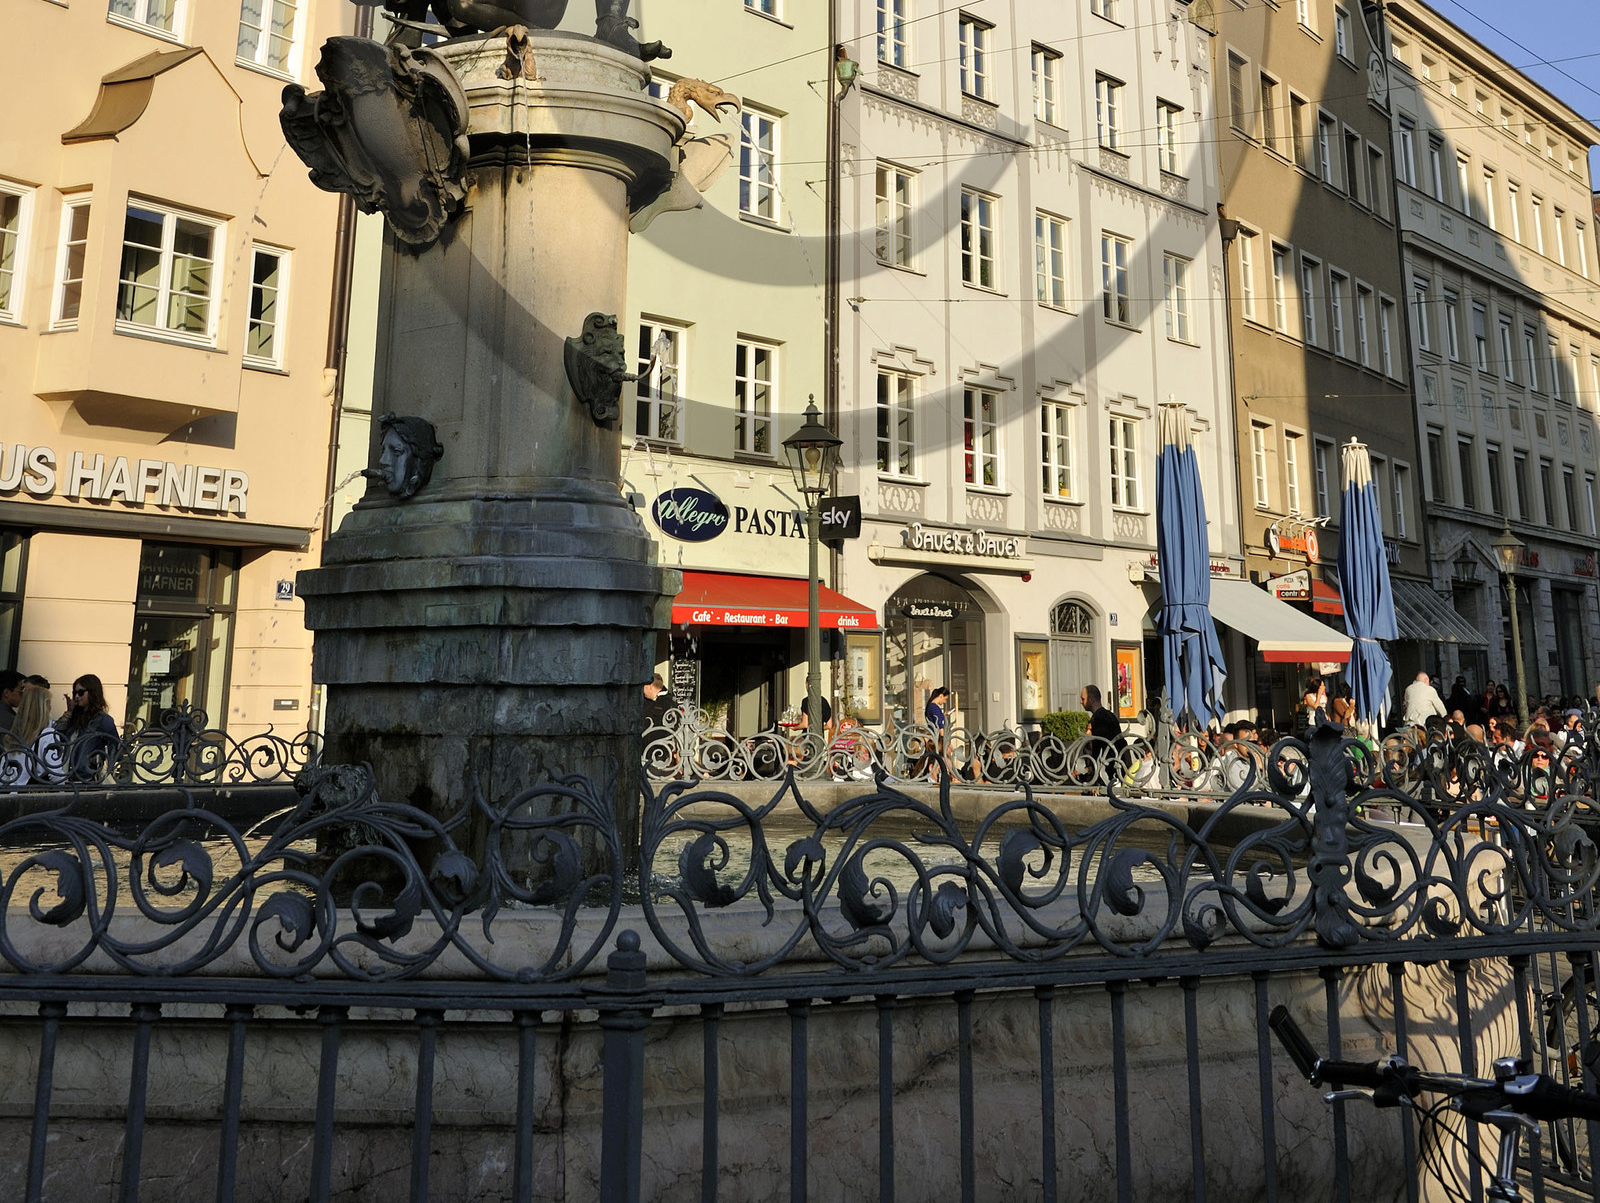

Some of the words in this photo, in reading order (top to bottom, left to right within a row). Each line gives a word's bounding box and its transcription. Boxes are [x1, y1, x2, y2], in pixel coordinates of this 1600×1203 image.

[67, 451, 250, 513] HAFNER
[733, 505, 807, 540] PASTA
[822, 506, 851, 529] sky
[142, 575, 194, 591] HAFNER
[280, 582, 290, 594] 29
[724, 612, 766, 624] Restaurant
[775, 614, 789, 625] Bar
[837, 615, 860, 627] drinks
